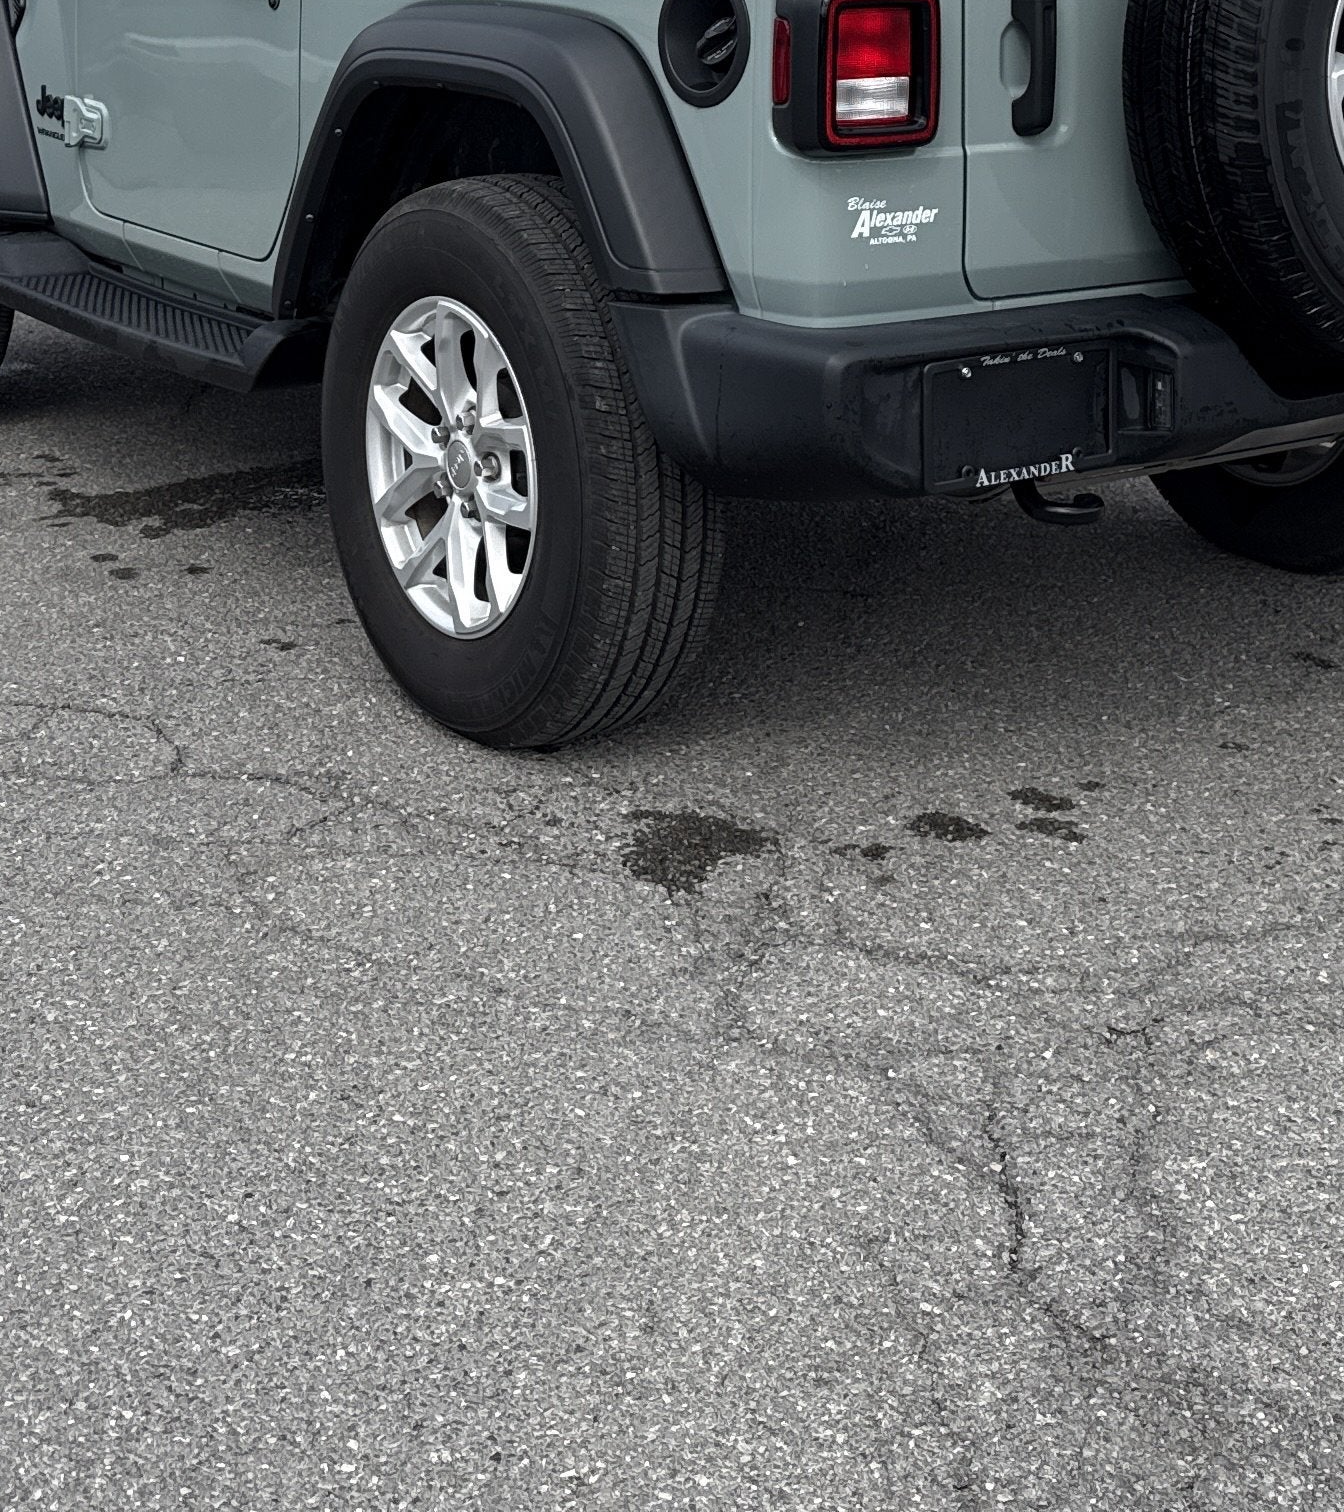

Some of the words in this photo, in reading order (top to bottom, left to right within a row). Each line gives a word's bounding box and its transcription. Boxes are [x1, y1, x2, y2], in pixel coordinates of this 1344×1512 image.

[847, 196, 887, 211] Blaise
[851, 205, 939, 239] Alexander
[906, 234, 917, 243] PA
[1017, 350, 1034, 362] the
[1037, 346, 1067, 359] Deals
[975, 453, 1075, 488] ALEXANDER
